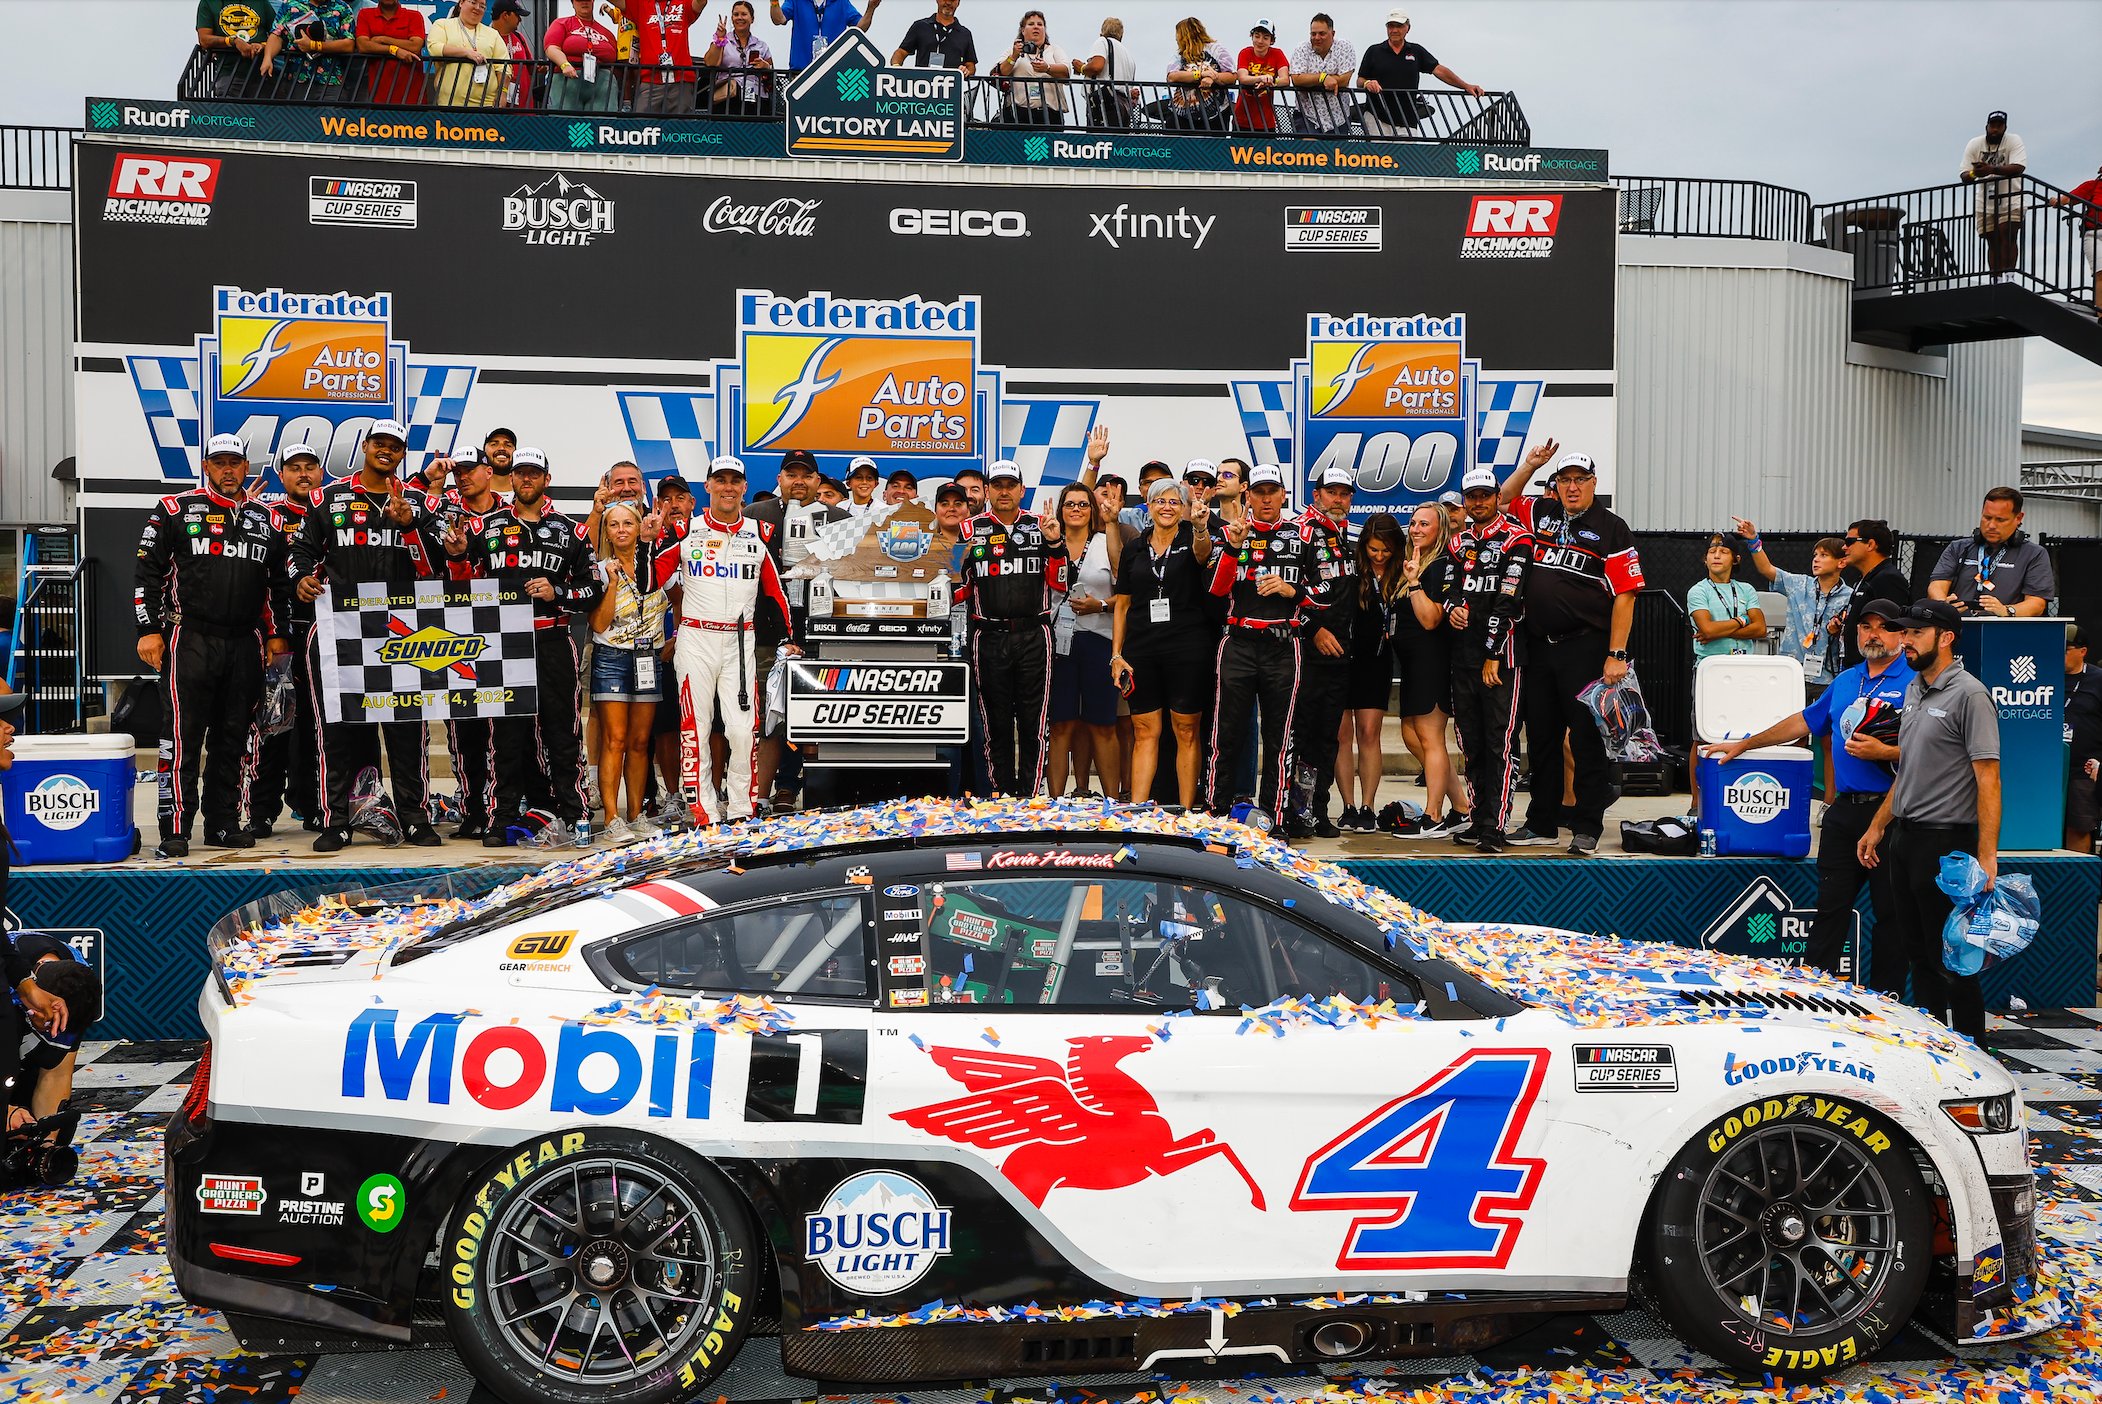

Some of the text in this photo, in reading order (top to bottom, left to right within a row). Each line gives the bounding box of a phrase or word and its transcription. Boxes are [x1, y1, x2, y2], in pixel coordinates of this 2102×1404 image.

[670, 4, 683, 14] 14
[876, 74, 955, 99] Ruoff
[124, 106, 256, 128] Ruoff MORTGAGE
[876, 102, 954, 116] MORTGAGE
[320, 116, 505, 142] Welcome home.
[599, 125, 723, 146] Ruoff MORTGAGE
[794, 115, 955, 138] VICTORY LANE
[1053, 140, 1172, 160] Ruoff MORTGAGE
[1230, 146, 1399, 169] Welcome home.
[1484, 153, 1598, 172] Ruoff MORTGAGE
[115, 158, 212, 199] RR
[343, 182, 402, 198] NASCAR
[104, 198, 211, 217] RICHMOND
[325, 202, 402, 217] CUP SERIES
[502, 197, 615, 234] BUSCH
[702, 195, 823, 237] Coca-Cola
[1315, 210, 1368, 224] NASCAR
[1472, 200, 1554, 233] RR
[158, 215, 207, 226] RACEWAY
[889, 208, 1027, 237] GEICO
[1089, 204, 1216, 249] xfinity
[525, 230, 590, 247] LIGHT
[1298, 230, 1368, 242] CUP SERIES
[1461, 237, 1554, 251] RICHMOND
[1507, 250, 1551, 258] RACEWAY
[218, 289, 388, 317] Federated
[742, 294, 976, 331] Federated
[1311, 316, 1462, 337] Federated
[312, 344, 381, 369] Auto
[303, 368, 381, 392] Parts
[1393, 365, 1455, 386] Auto
[327, 391, 382, 399] PROFESSIONALS
[871, 372, 966, 406] Auto
[1384, 387, 1456, 409] Parts
[857, 406, 966, 441] Parts
[890, 440, 966, 450] PROFESSIONALS
[1308, 432, 1458, 493] 400
[337, 528, 392, 547] Mobil
[191, 537, 248, 559] Mobil
[1534, 544, 1566, 565] obil
[490, 551, 542, 570] Mobil
[688, 560, 738, 579] Mobil
[975, 558, 1023, 577] Mobil
[343, 591, 518, 607] FEDERATED AUTO PARTS 400
[813, 623, 837, 632] BUSCH
[917, 624, 943, 635] xfinity
[385, 638, 480, 660] SUNOCO
[846, 668, 943, 692] NASCAR
[361, 690, 515, 709] AUGUST 14, 2022
[1992, 686, 2054, 706] Ruoff
[812, 703, 944, 725] CUP SERIES
[680, 729, 698, 782] Mobil
[29, 792, 96, 812] BUSCH
[1727, 788, 1786, 807] BUSCH
[44, 810, 82, 821] LIGHT
[1738, 806, 1774, 815] LIGHT
[987, 850, 1114, 870] Kevin Harvick
[885, 911, 910, 919] Mobil
[963, 915, 987, 927] HUNT
[953, 919, 993, 935] BROTHERS
[960, 928, 984, 939] PIZZA
[514, 935, 568, 954] GW
[887, 932, 923, 943] HAAS
[499, 963, 571, 973] GEARWRENCH
[894, 990, 923, 999] RUSH
[341, 1008, 716, 1120] Mobil
[1603, 1048, 1658, 1063] NASCAR
[1589, 1067, 1661, 1082] CUP SERIES
[1289, 1048, 1551, 1270] 4
[202, 1189, 260, 1200] BROTHERS
[215, 1180, 247, 1190] HUNT
[214, 1200, 248, 1209] PIZZA
[278, 1200, 345, 1215] PRISTINE
[279, 1213, 344, 1226] AUCTION
[808, 1212, 948, 1256] BUSCH
[836, 1253, 919, 1274] LIGHT
[1974, 1258, 2002, 1281] SUNOCO
[676, 1288, 742, 1389] EAGLE
[1761, 1335, 1858, 1370] EAGLE
